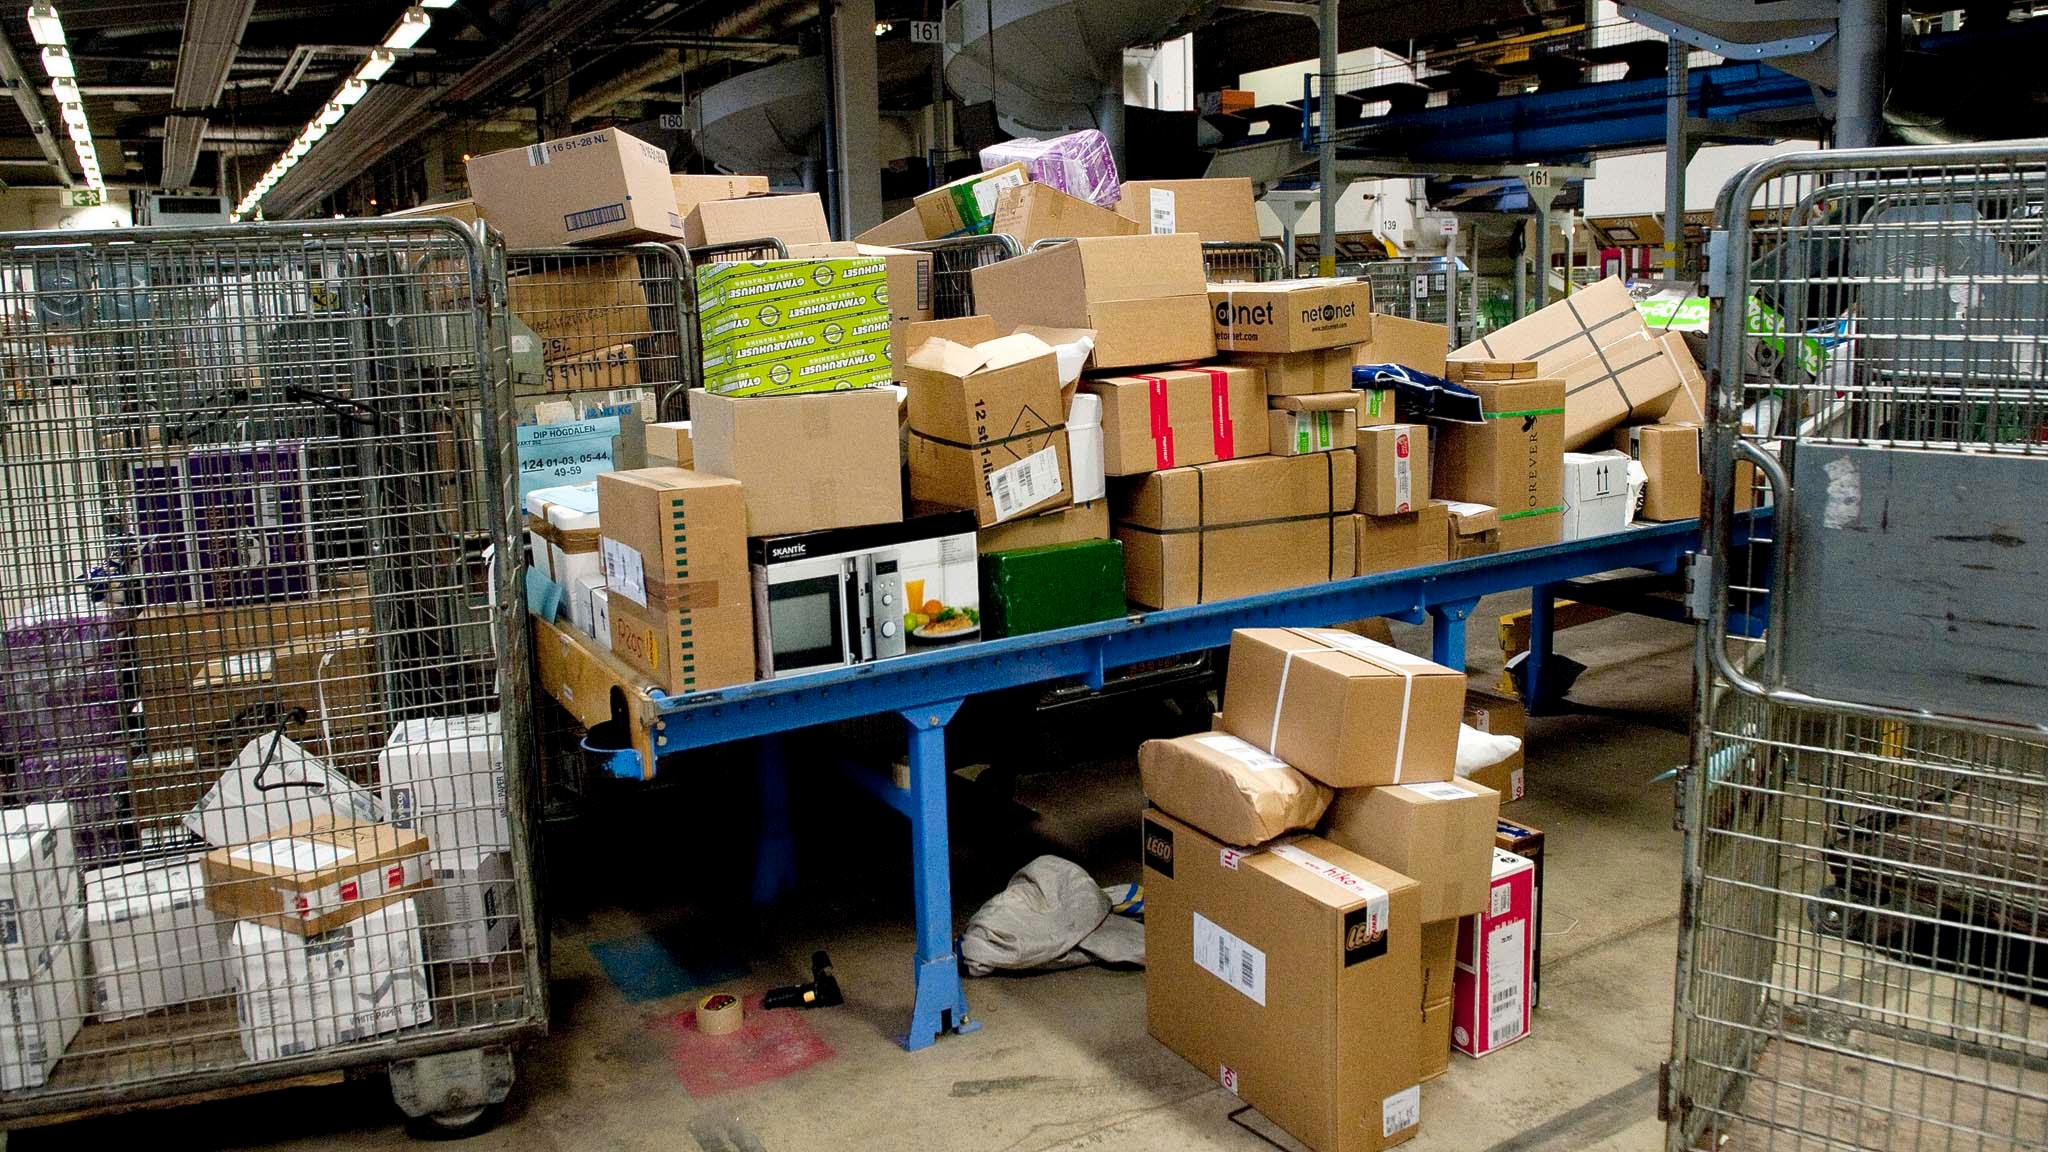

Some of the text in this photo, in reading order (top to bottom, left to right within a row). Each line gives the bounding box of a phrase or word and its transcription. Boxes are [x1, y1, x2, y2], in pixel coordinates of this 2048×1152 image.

[914, 22, 940, 41] 161
[661, 115, 683, 128] 160
[553, 134, 609, 153] 16 51-28 NL
[1529, 170, 1548, 185] 161
[1383, 220, 1397, 230] 139
[787, 296, 867, 319] GYMVARUHUSET
[735, 335, 816, 359] GYMVARUHUSET
[799, 353, 877, 377] GYMVARUHUSET
[974, 399, 987, 421] 12
[533, 431, 548, 440] DIP
[977, 426, 990, 442] st
[522, 458, 544, 471] 124
[554, 466, 582, 477] 49-59
[1529, 432, 1538, 507] OREVER
[1146, 836, 1171, 860] LEGO
[1322, 866, 1357, 887] hiko
